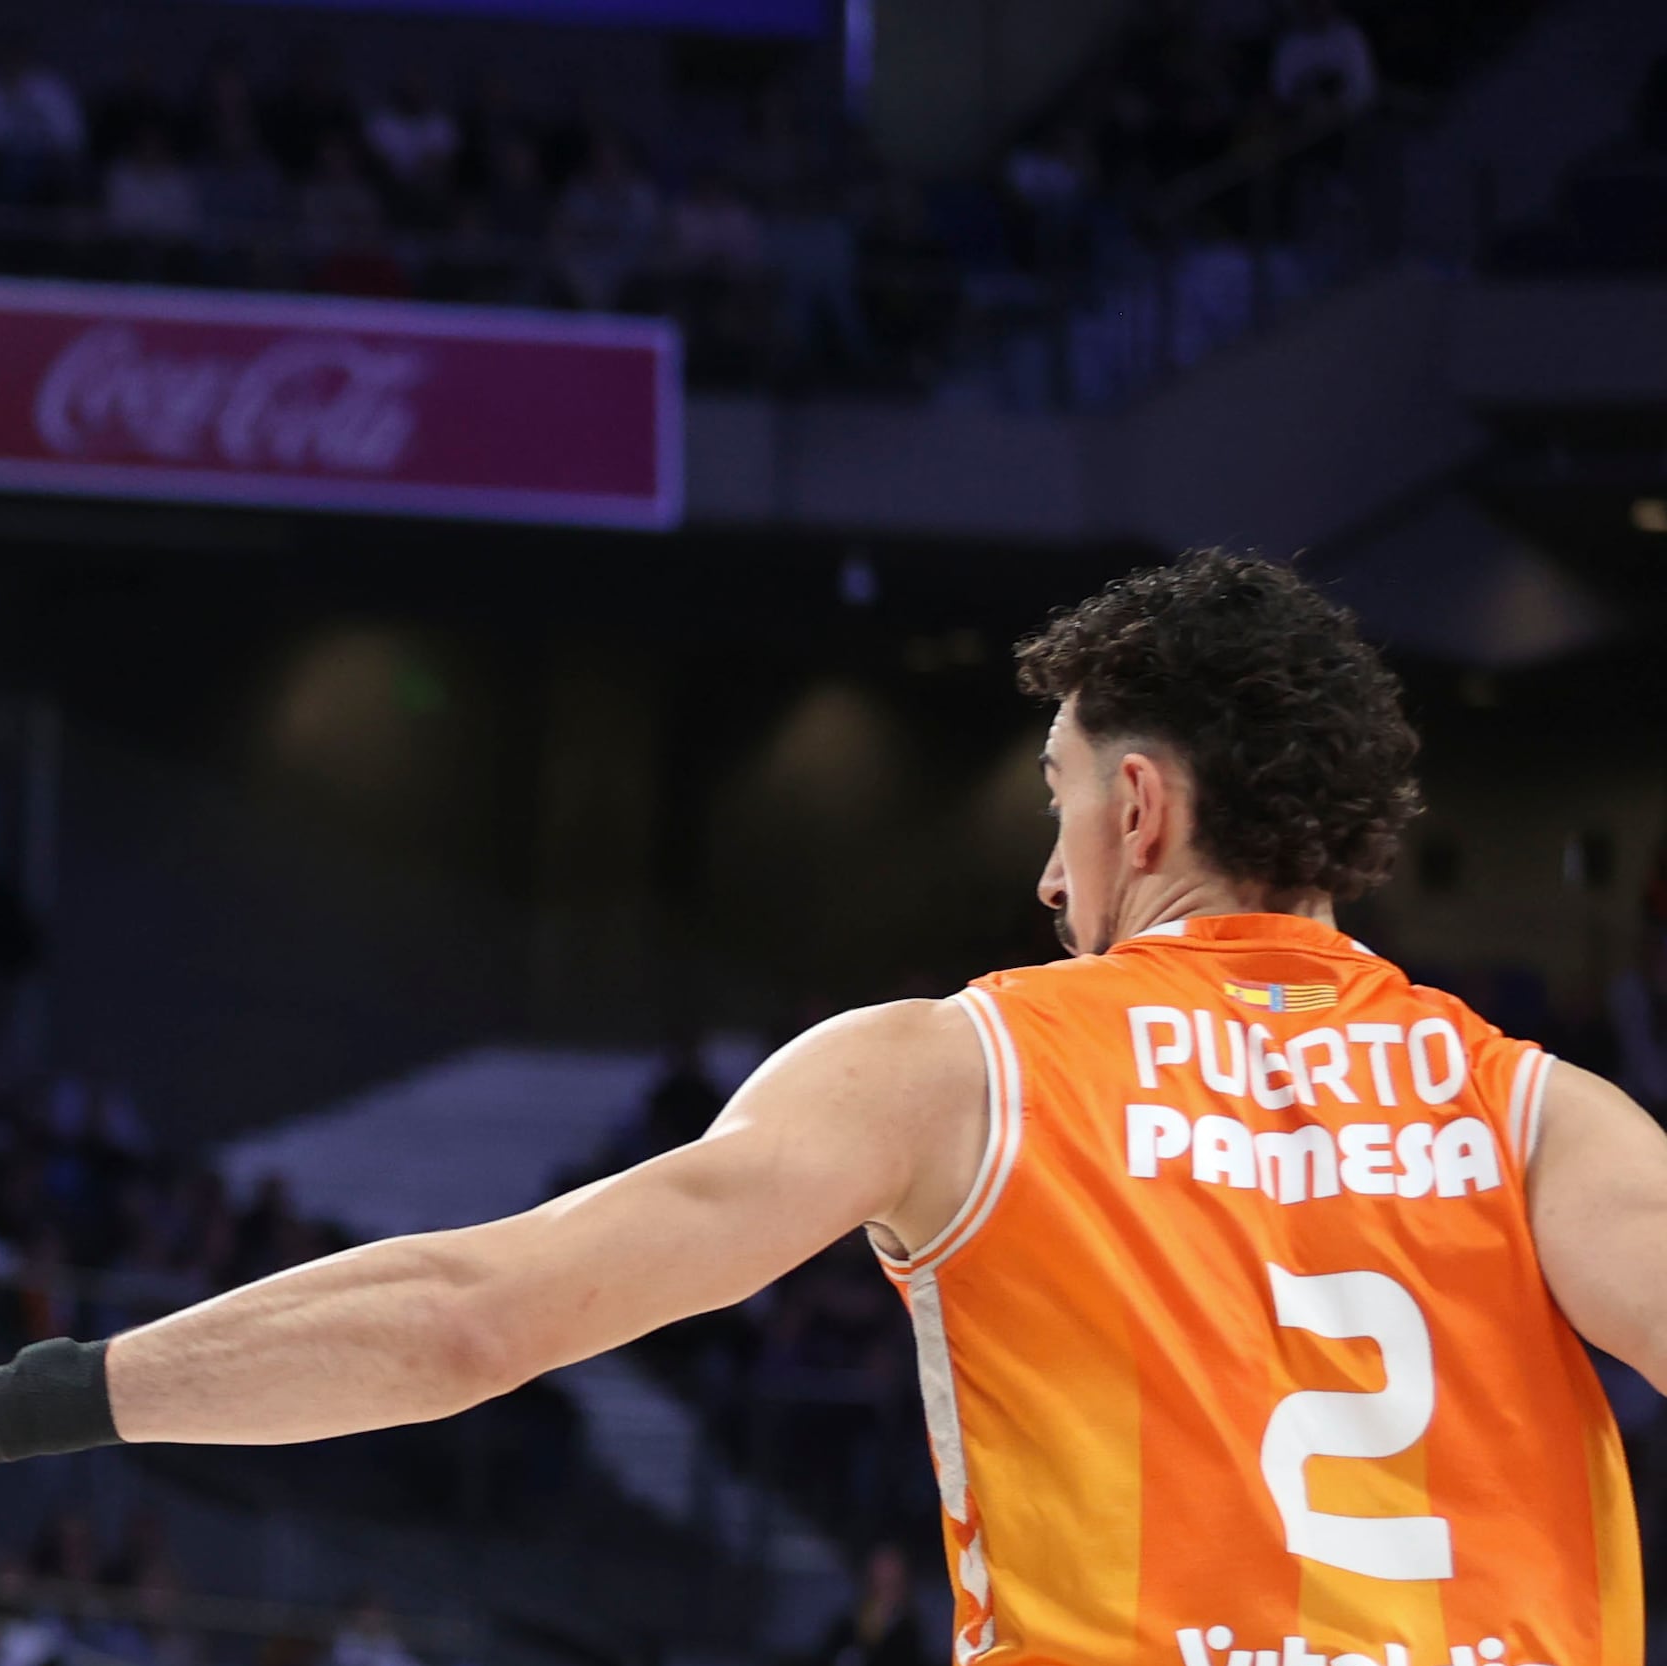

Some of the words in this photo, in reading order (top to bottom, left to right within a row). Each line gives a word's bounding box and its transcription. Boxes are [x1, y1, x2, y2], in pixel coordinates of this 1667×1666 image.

[1126, 1005, 1467, 1110] PUERTO
[1126, 1104, 1501, 1205] PAMESA
[1260, 1261, 1454, 1581] 2
